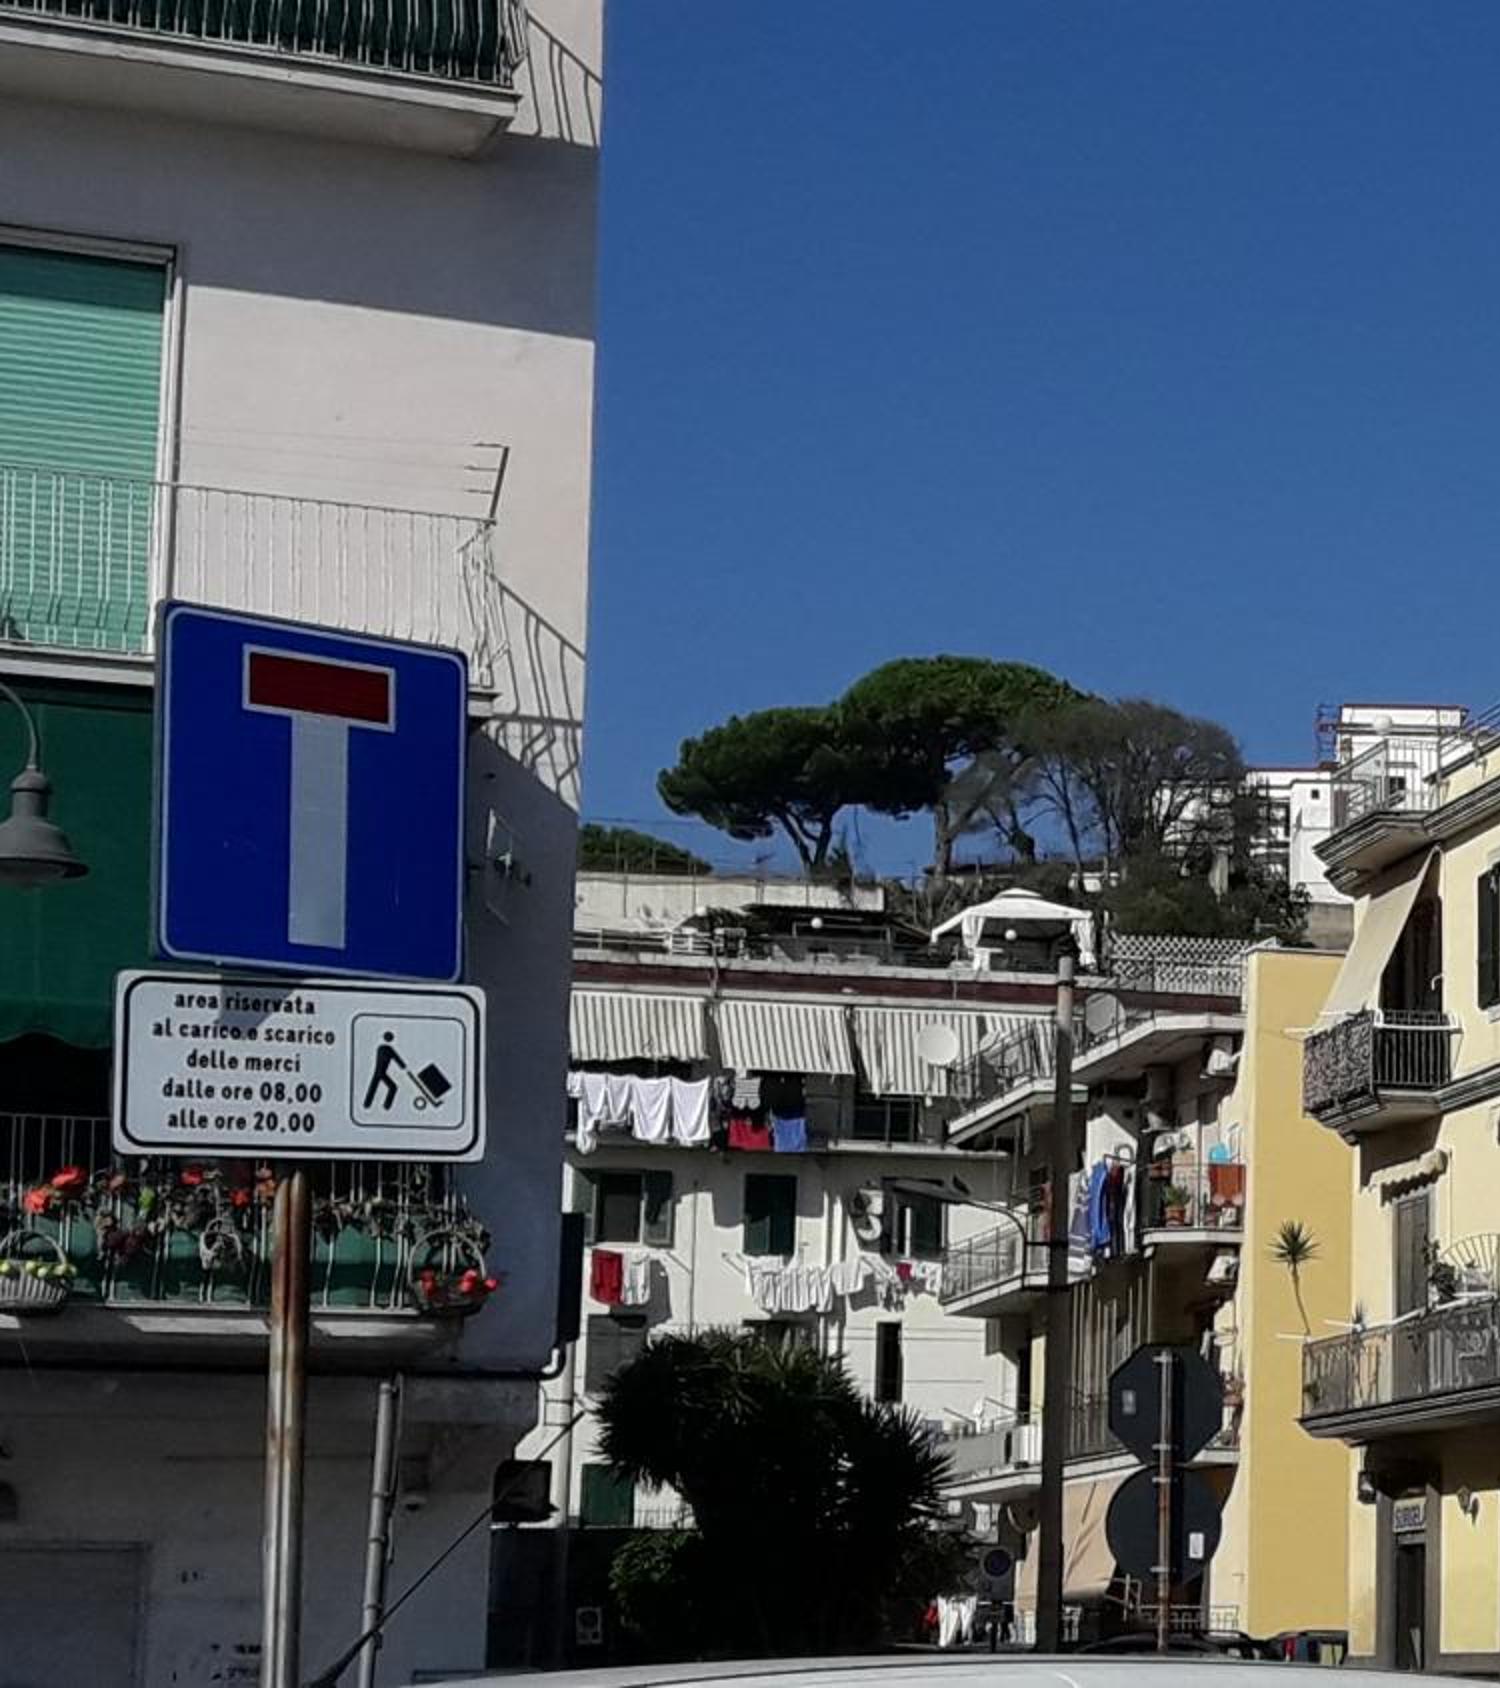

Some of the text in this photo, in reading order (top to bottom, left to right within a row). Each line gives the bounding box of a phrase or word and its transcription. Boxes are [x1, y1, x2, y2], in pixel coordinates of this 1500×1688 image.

[175, 991, 315, 1014] area riservata
[153, 1017, 335, 1045] al carico e scarico
[187, 1048, 300, 1073] delle merci
[162, 1077, 215, 1099] dalle
[221, 1085, 253, 1100] ore
[168, 1108, 315, 1133] alle ore 20.00
